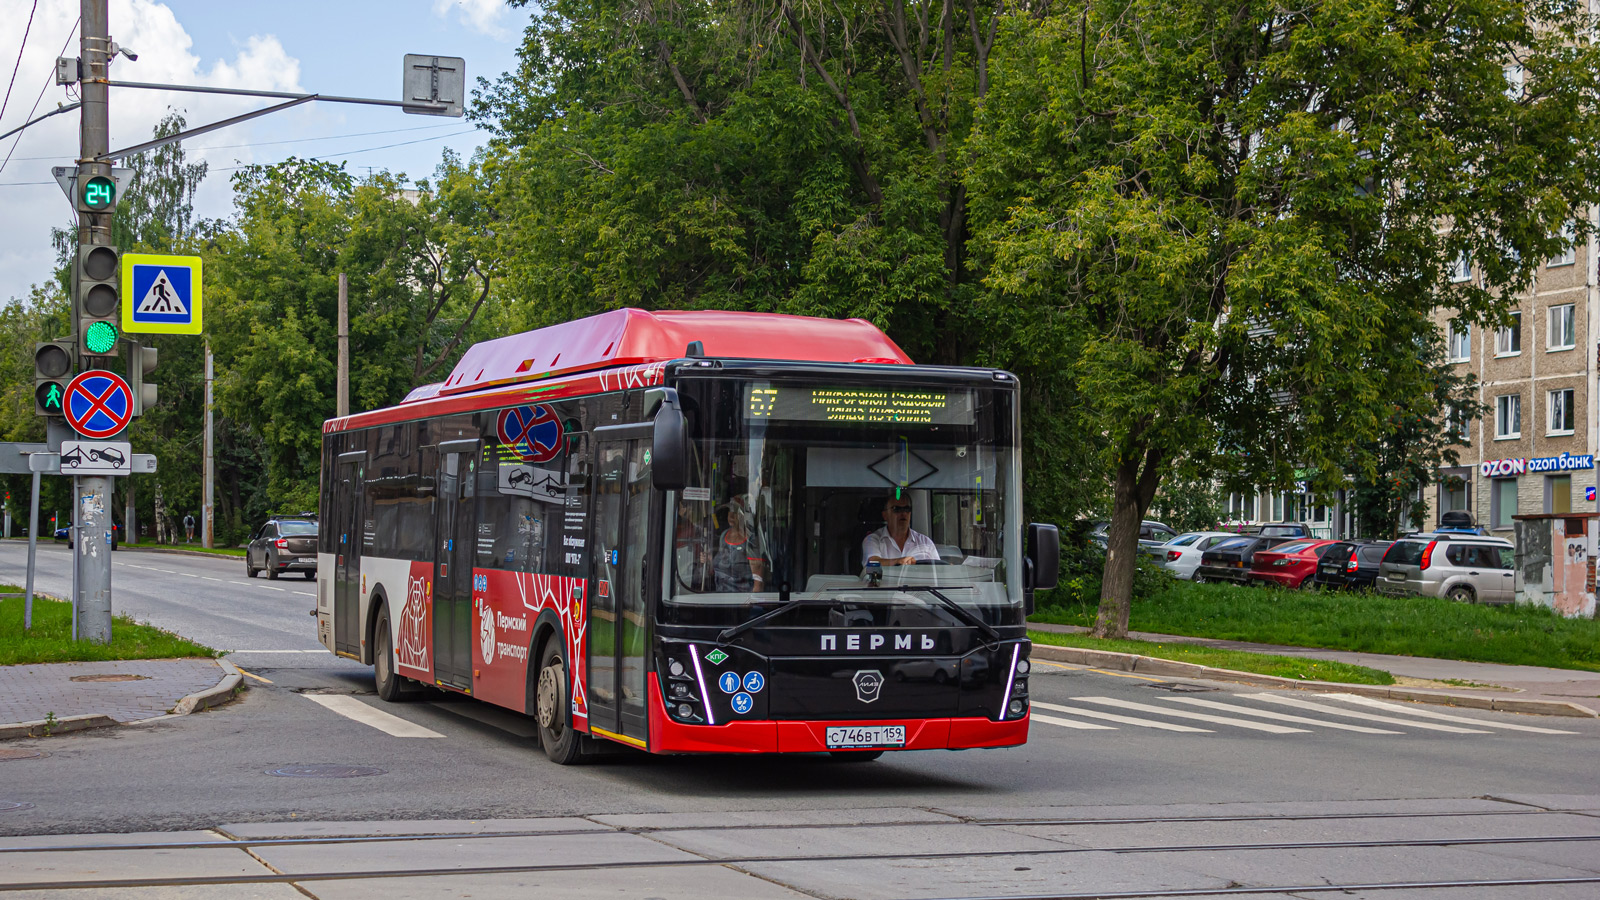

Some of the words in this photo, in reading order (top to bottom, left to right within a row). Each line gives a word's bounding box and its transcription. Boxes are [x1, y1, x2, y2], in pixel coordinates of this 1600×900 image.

[86, 184, 110, 204] 24
[751, 389, 778, 416] 67
[1480, 458, 1526, 477] OZON
[1528, 458, 1557, 471] ozon
[1559, 452, 1593, 469] банк
[497, 611, 527, 632] Пермский
[497, 641, 527, 663] транспорт
[820, 635, 935, 650] ПЕРМЬ
[883, 728, 901, 738] 159
